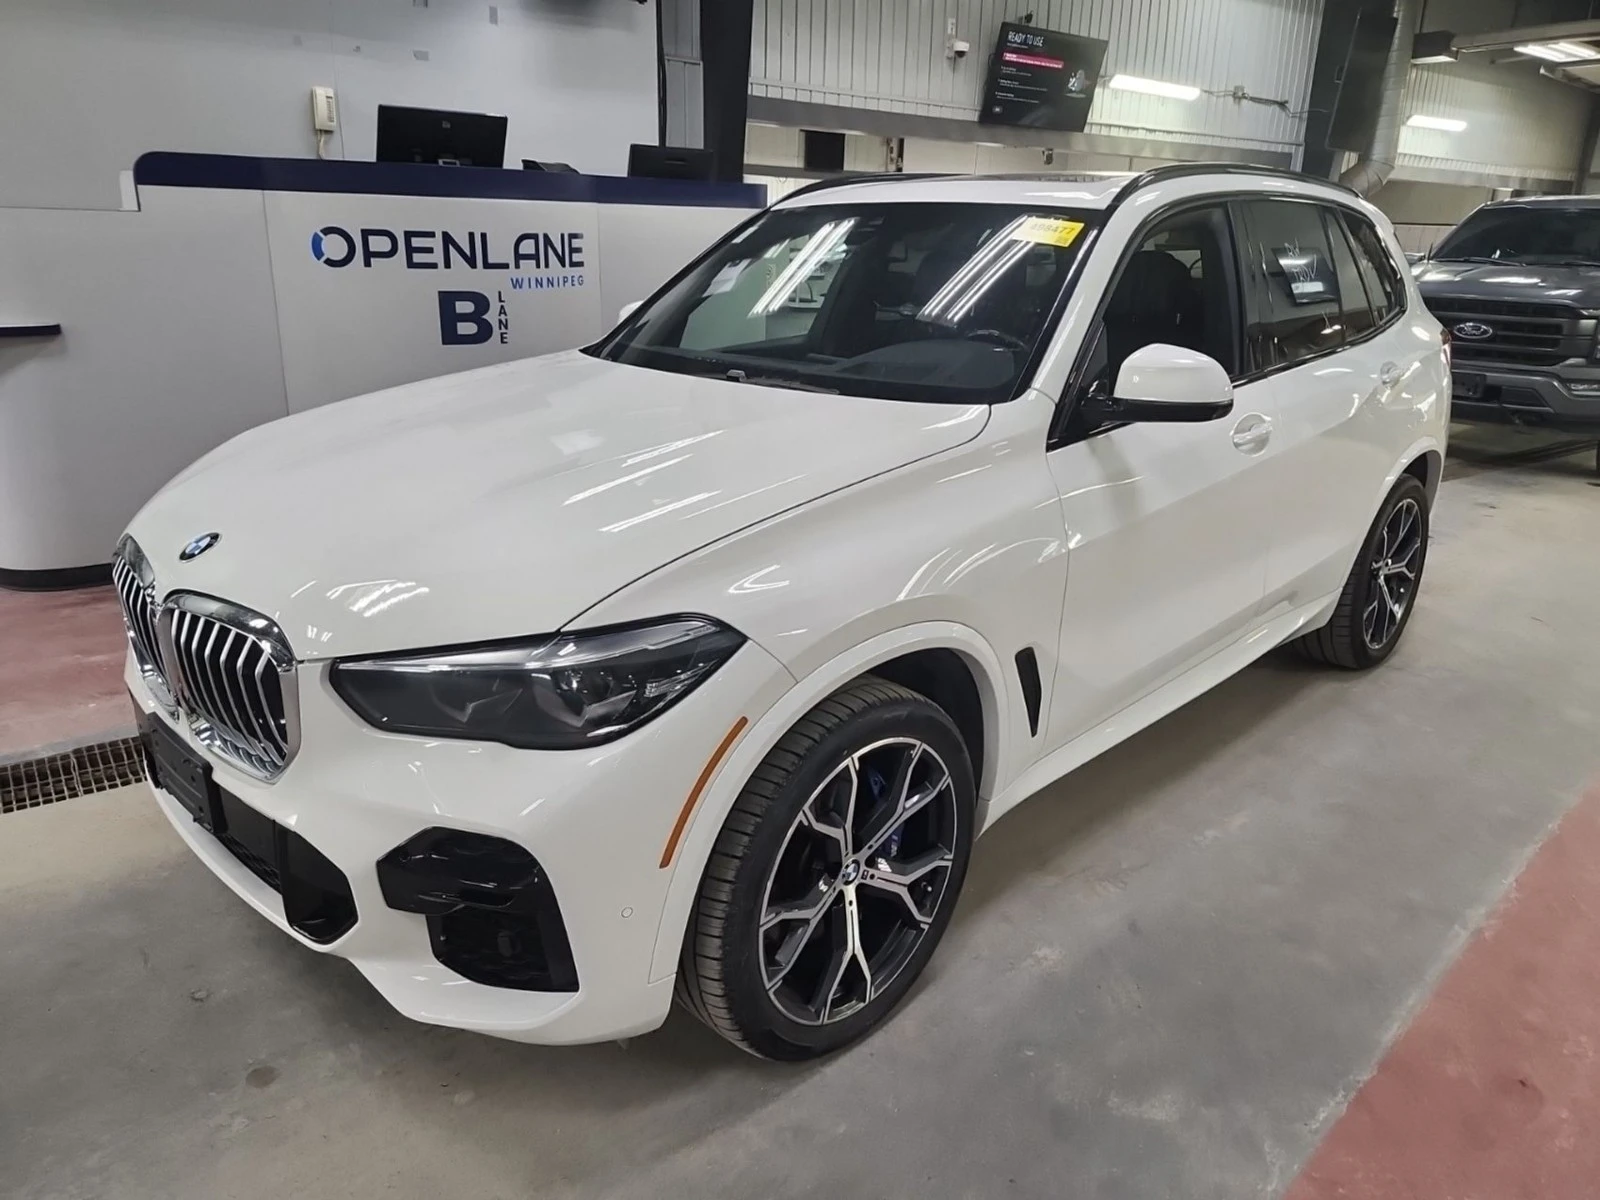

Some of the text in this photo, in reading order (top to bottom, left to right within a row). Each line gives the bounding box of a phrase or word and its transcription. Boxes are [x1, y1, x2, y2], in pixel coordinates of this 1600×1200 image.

[1008, 31, 1026, 43] READY
[1026, 33, 1034, 46] TO
[1034, 36, 1044, 47] USE
[311, 226, 585, 269] OPENLANE
[510, 275, 585, 290] WINNIPEG
[437, 290, 509, 346] B LANE
